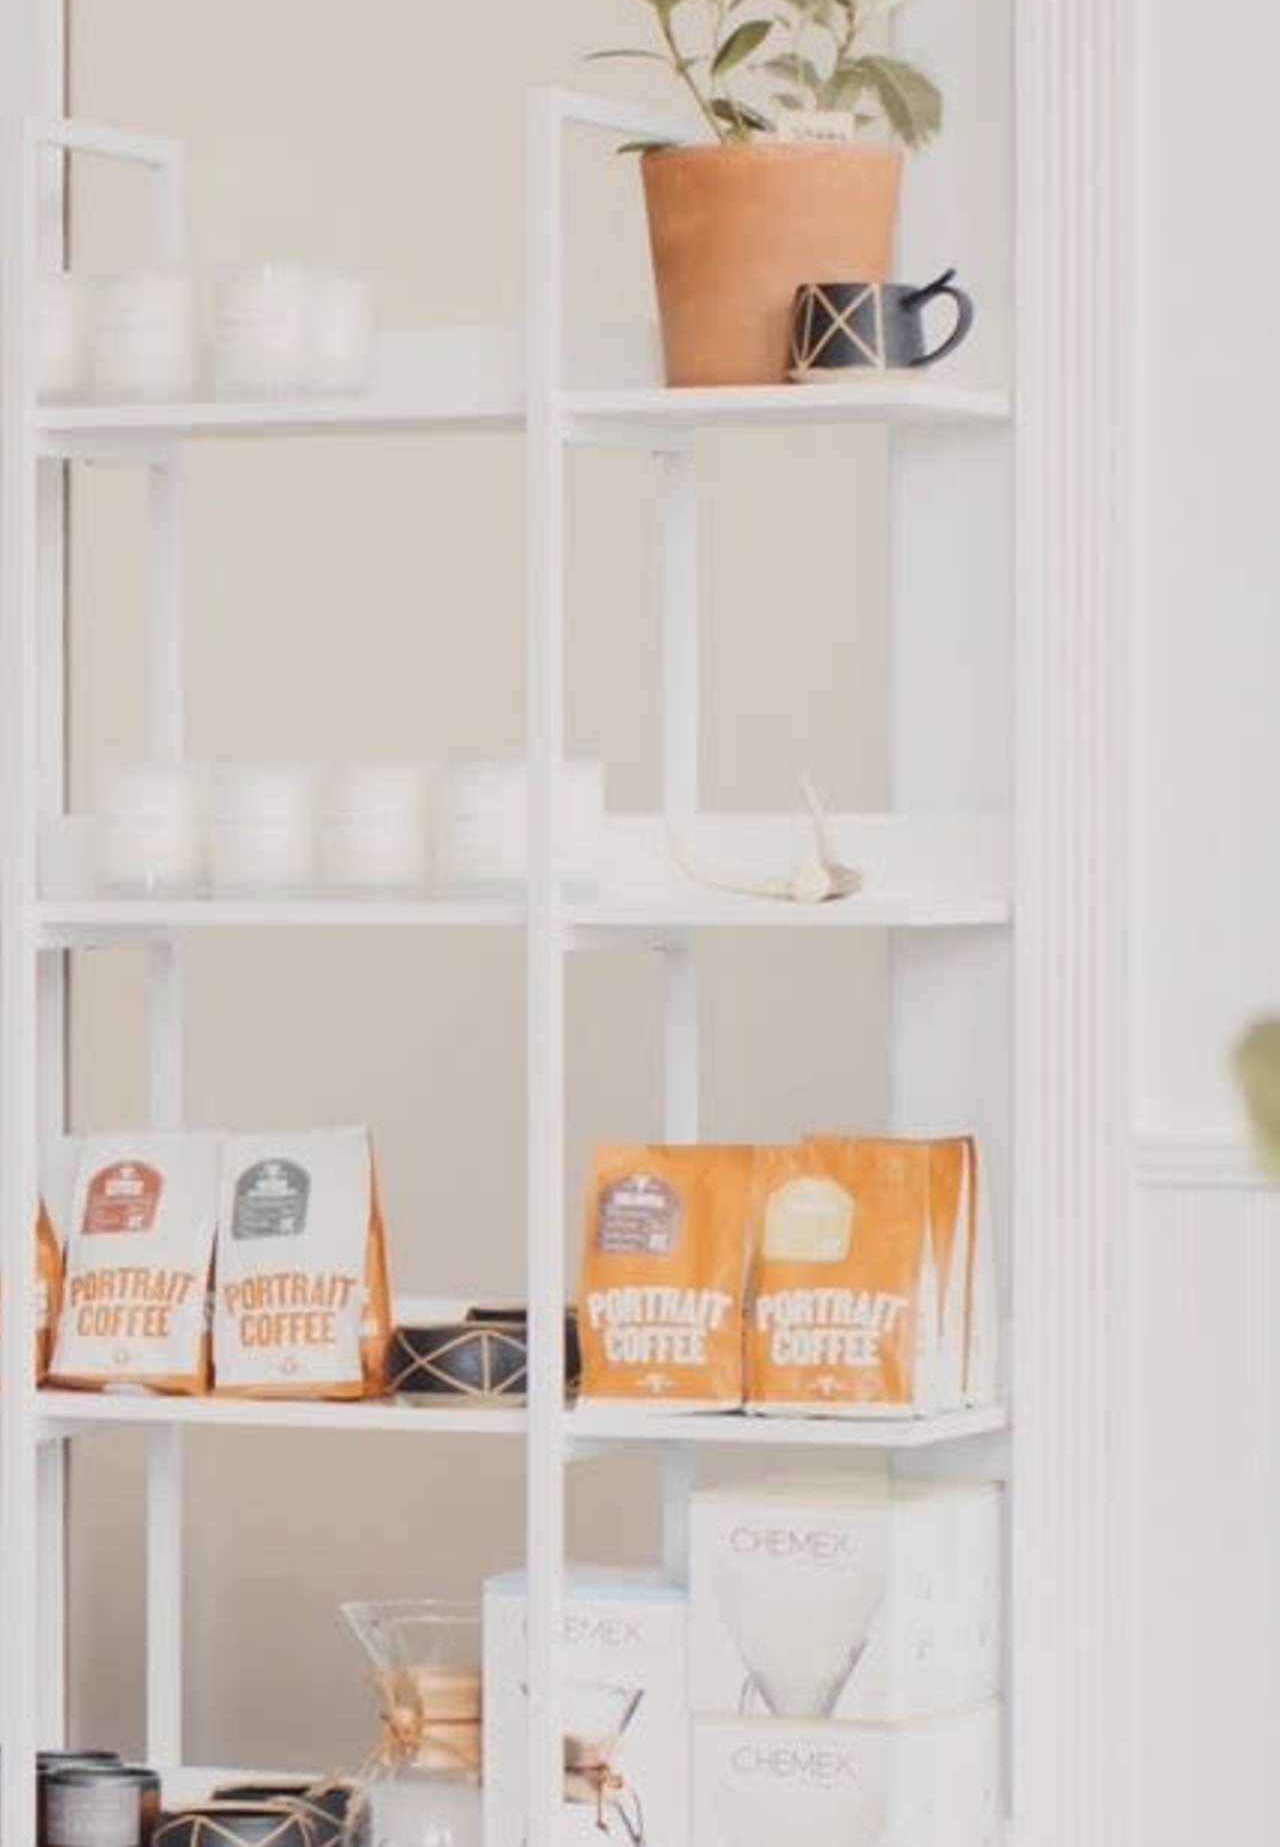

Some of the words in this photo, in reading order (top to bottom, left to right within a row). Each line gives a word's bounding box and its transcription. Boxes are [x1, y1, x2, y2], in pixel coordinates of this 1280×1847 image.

[70, 1267, 196, 1305] PORTRAIT
[224, 1271, 356, 1314] PORTRAIT
[77, 1305, 171, 1337] COFFEE
[587, 1286, 733, 1330] PORTRAIT
[756, 1288, 908, 1331] PORTRAIT
[240, 1311, 337, 1347] COFFEE
[606, 1326, 706, 1364] COFFEE
[772, 1328, 881, 1365] COFFEE
[729, 1527, 851, 1559] CHEMEX
[729, 1744, 855, 1784] CHEMEX
